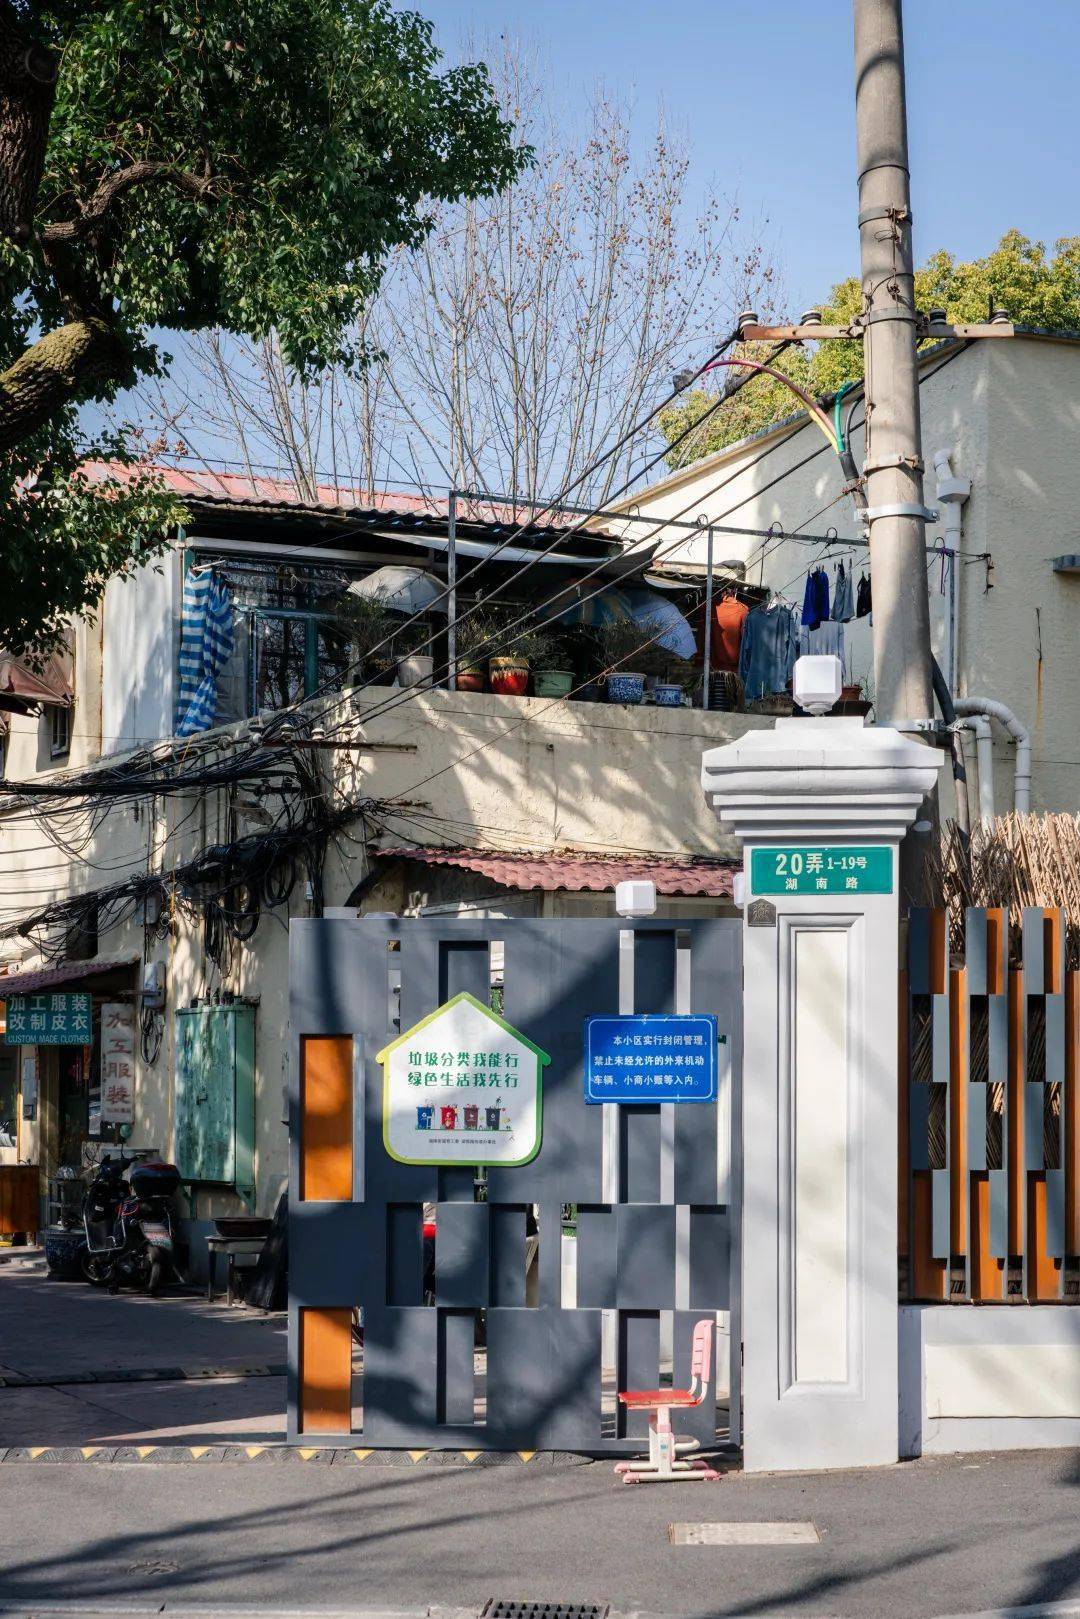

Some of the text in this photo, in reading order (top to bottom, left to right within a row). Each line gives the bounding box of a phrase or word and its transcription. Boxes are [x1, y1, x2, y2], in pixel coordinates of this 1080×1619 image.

[9, 994, 88, 1012] 加工服装
[9, 1013, 88, 1031] 改制皮衣
[8, 1034, 90, 1043] CUSTOM MADE CLOTHES
[407, 1051, 520, 1068] 垃圾分类我能行
[594, 1055, 705, 1066] 禁止未经允许的外来机动
[407, 1071, 519, 1088] 绿色生活我先行
